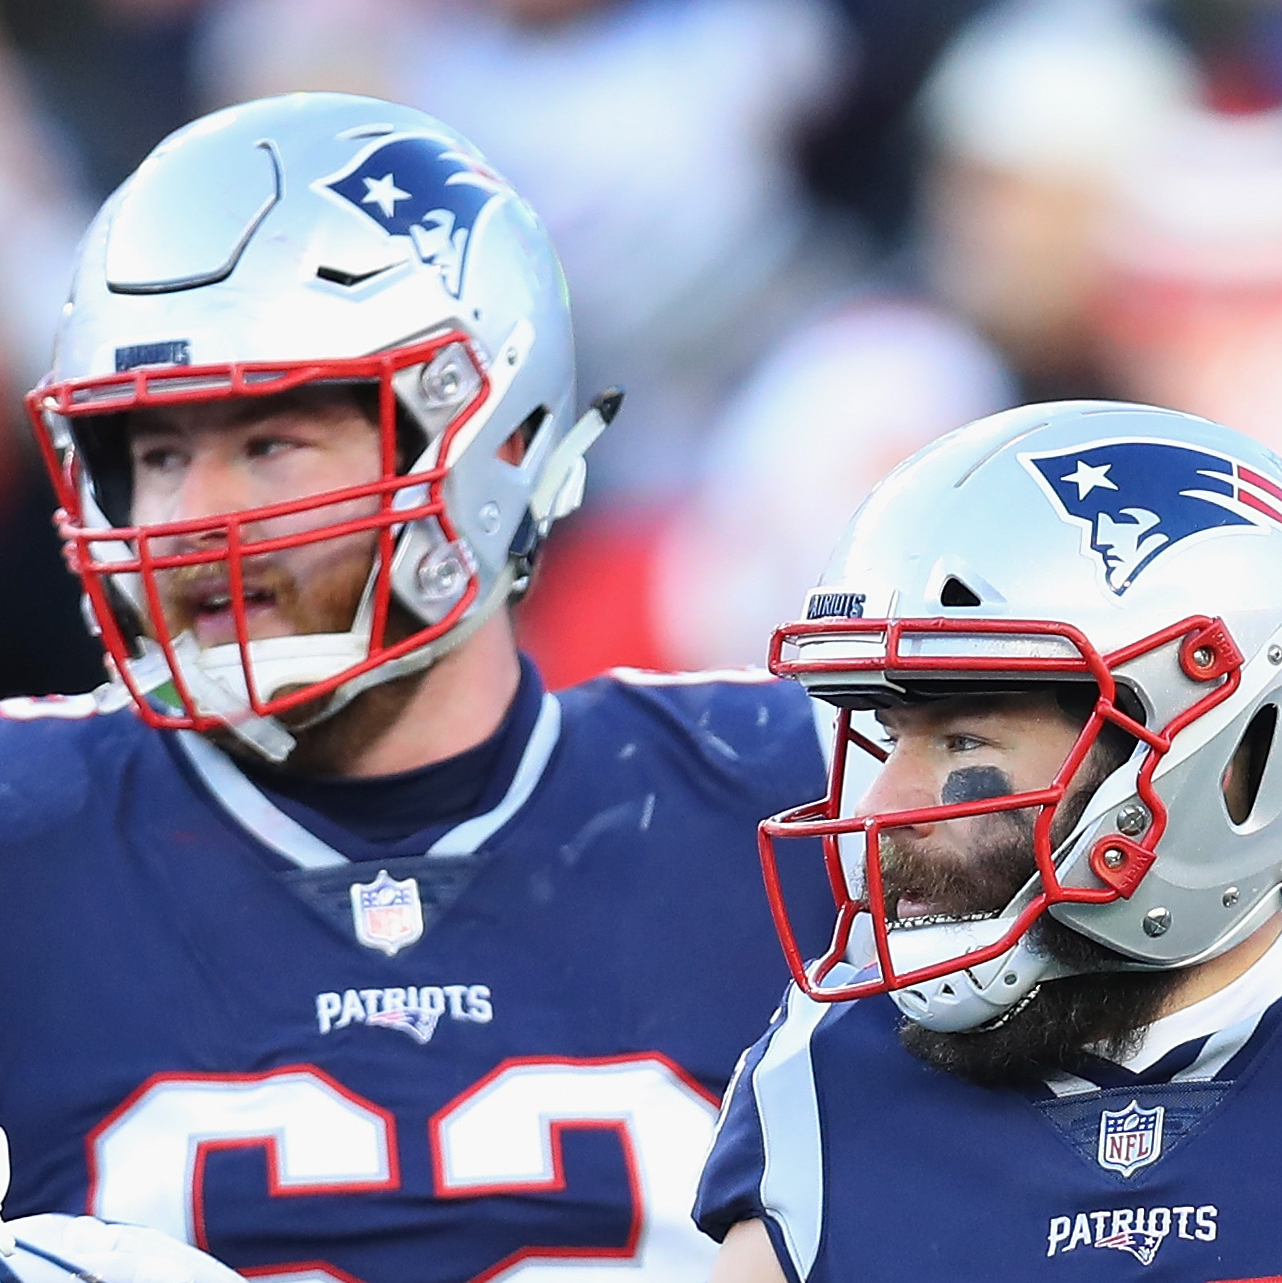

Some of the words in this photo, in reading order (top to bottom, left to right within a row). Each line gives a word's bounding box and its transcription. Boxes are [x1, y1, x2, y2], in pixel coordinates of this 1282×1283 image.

[316, 984, 493, 1036] PATRIOTS
[1108, 1132, 1149, 1161] NFL
[1046, 1204, 1218, 1258] PATRIOTS
